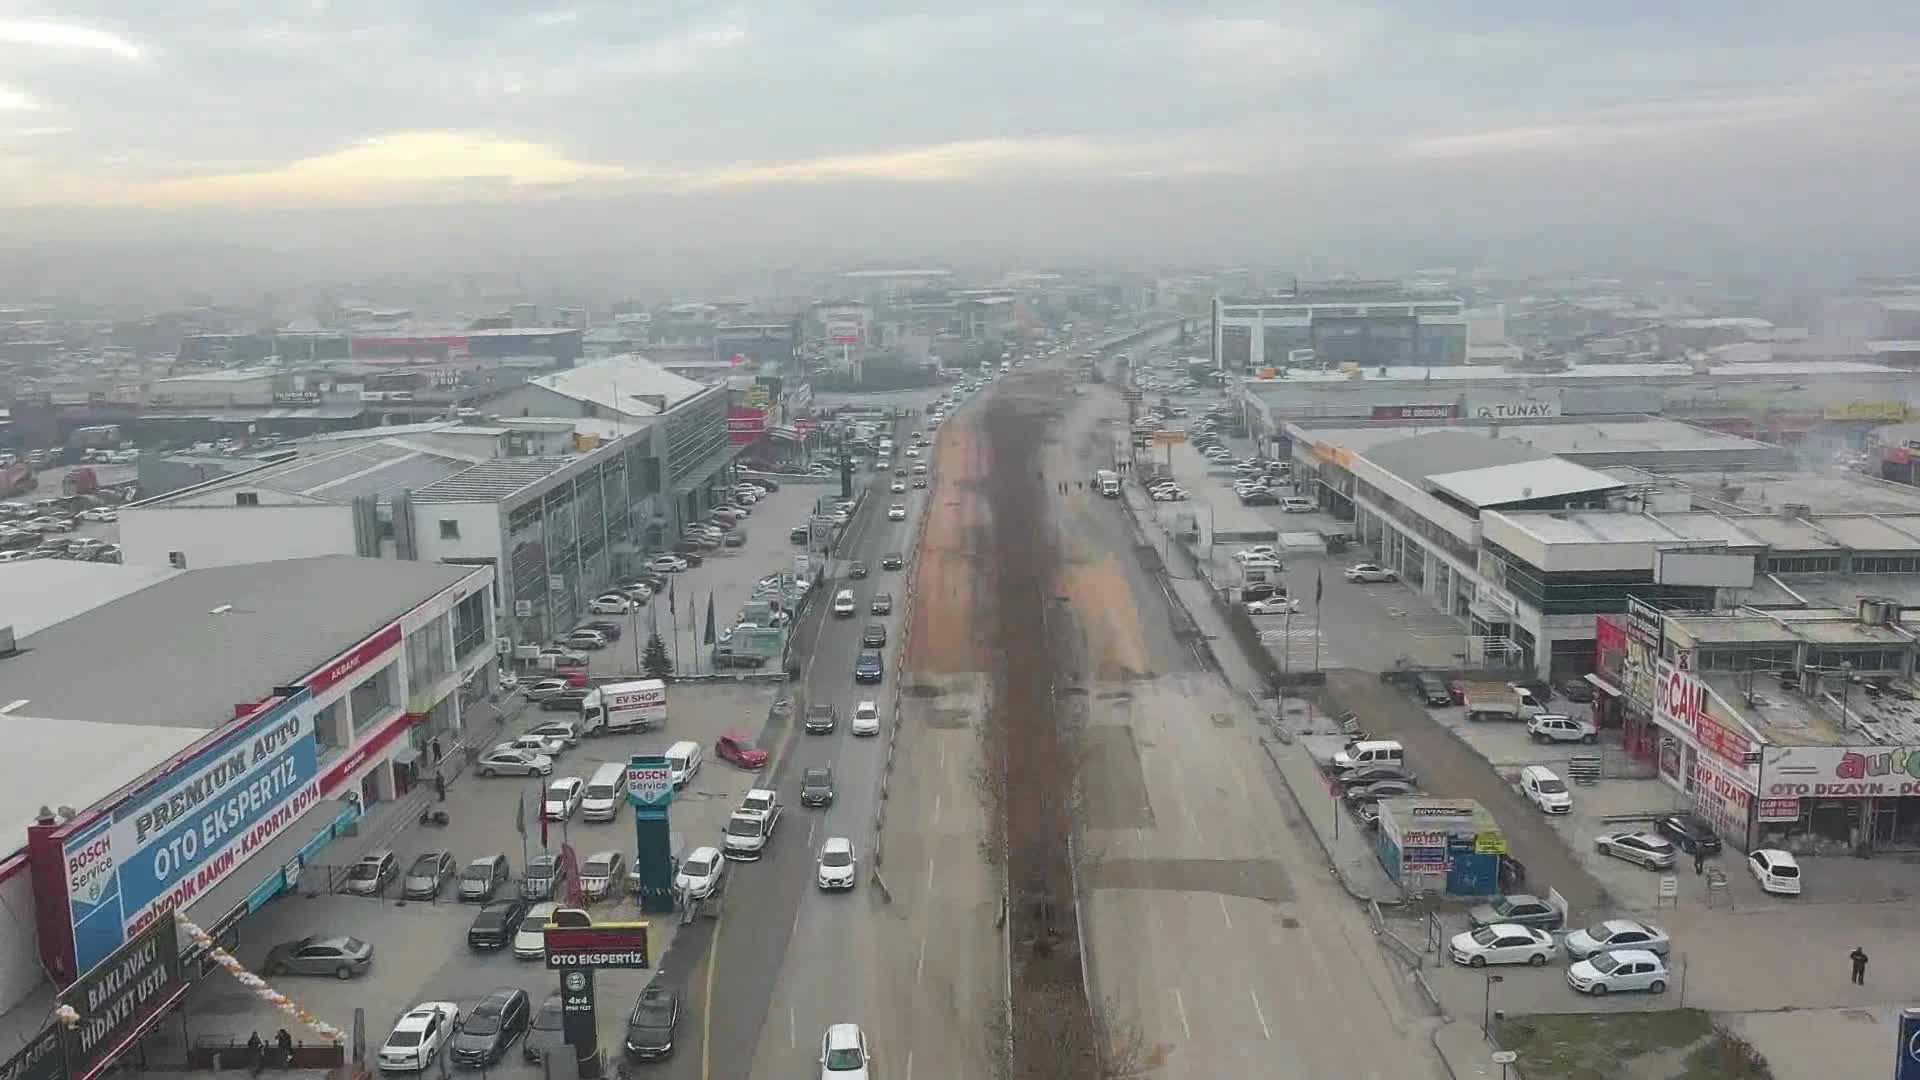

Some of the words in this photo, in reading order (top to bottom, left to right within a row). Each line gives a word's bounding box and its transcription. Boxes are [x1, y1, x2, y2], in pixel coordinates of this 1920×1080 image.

[1496, 404, 1549, 417] TUNAY
[616, 696, 629, 704] EV
[631, 692, 658, 702] SHOP
[629, 771, 667, 780] BOSCH
[630, 781, 668, 790] Service
[1770, 784, 1809, 795] OTO
[135, 750, 247, 844] PREMIUM
[154, 828, 198, 880] OTO
[202, 755, 297, 848] EKSPERTİZ
[70, 833, 111, 874] BOSCH
[199, 850, 234, 891] BAKIM
[240, 805, 292, 857] KAPORTA
[293, 782, 319, 815] BOYA
[72, 856, 112, 892] Service
[88, 937, 157, 1012] BAKLAVACI
[551, 954, 577, 965] OTO
[579, 951, 643, 964] EKSPERTİZ
[137, 964, 168, 1003] USTA
